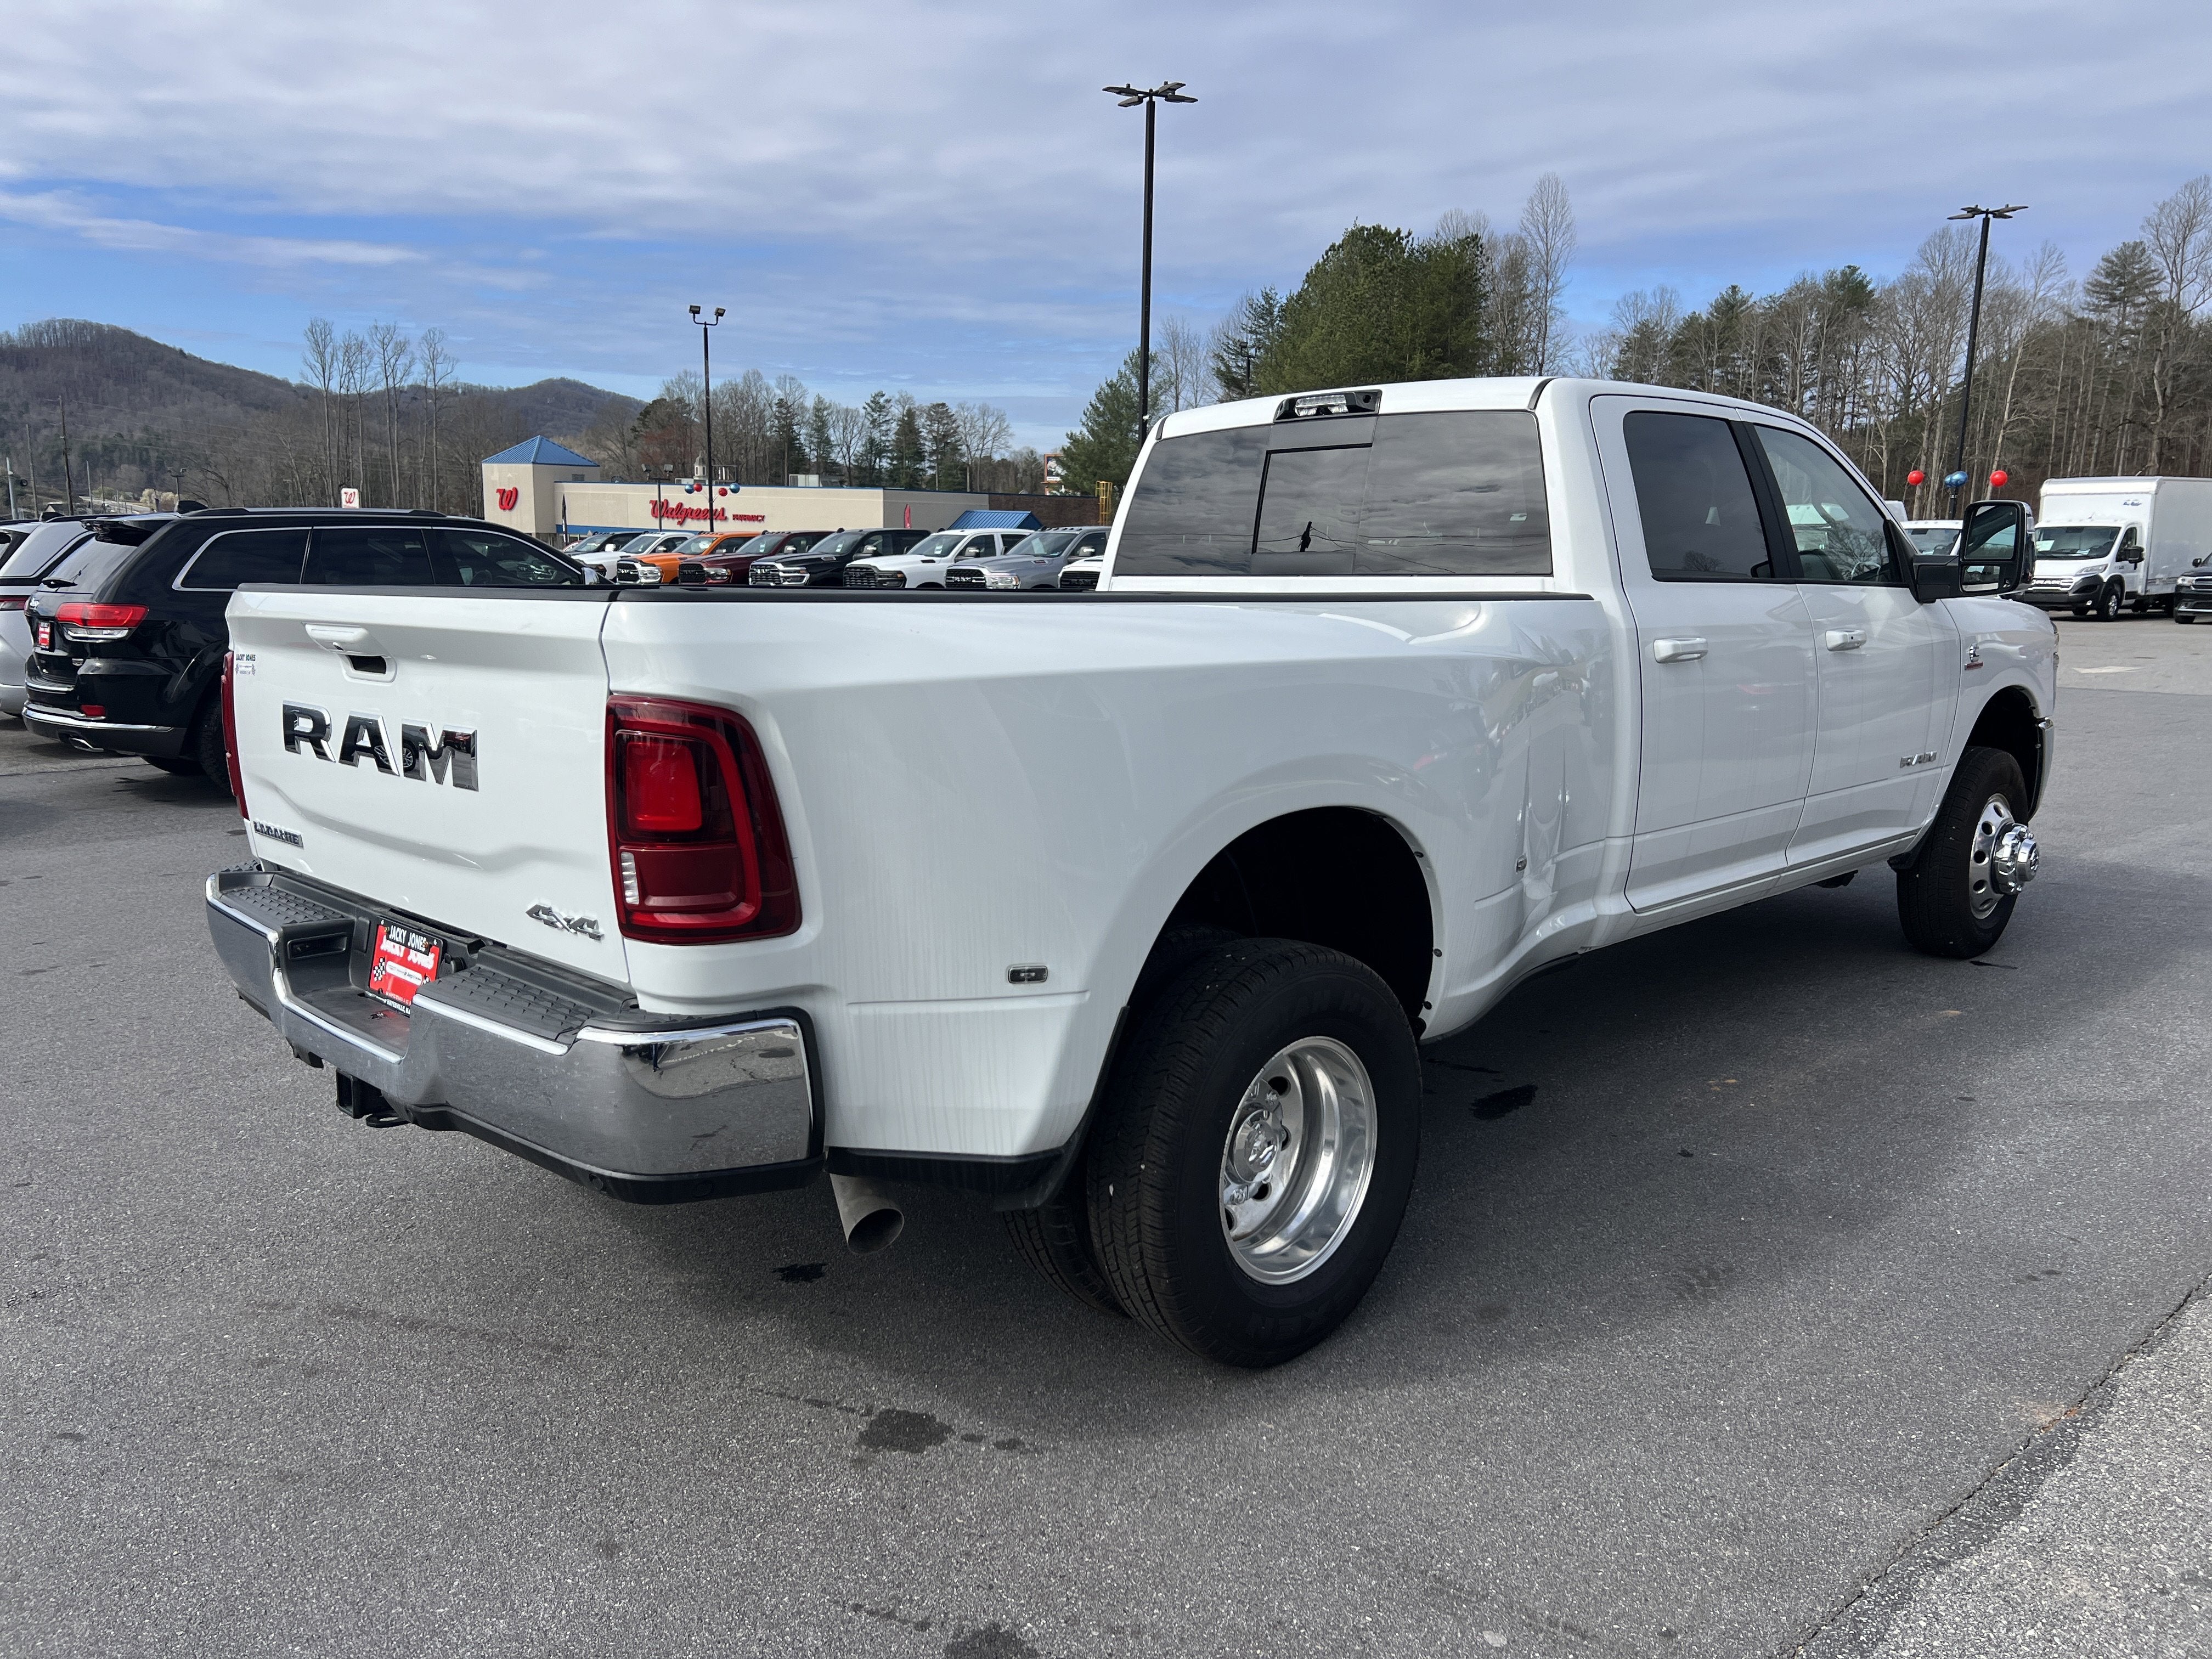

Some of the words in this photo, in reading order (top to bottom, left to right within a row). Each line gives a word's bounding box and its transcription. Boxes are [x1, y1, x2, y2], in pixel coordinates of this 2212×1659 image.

[344, 492, 356, 504] W
[495, 487, 518, 511] W
[282, 700, 479, 792] RAM
[1900, 752, 1937, 768] RAM
[389, 925, 407, 944] JACKY
